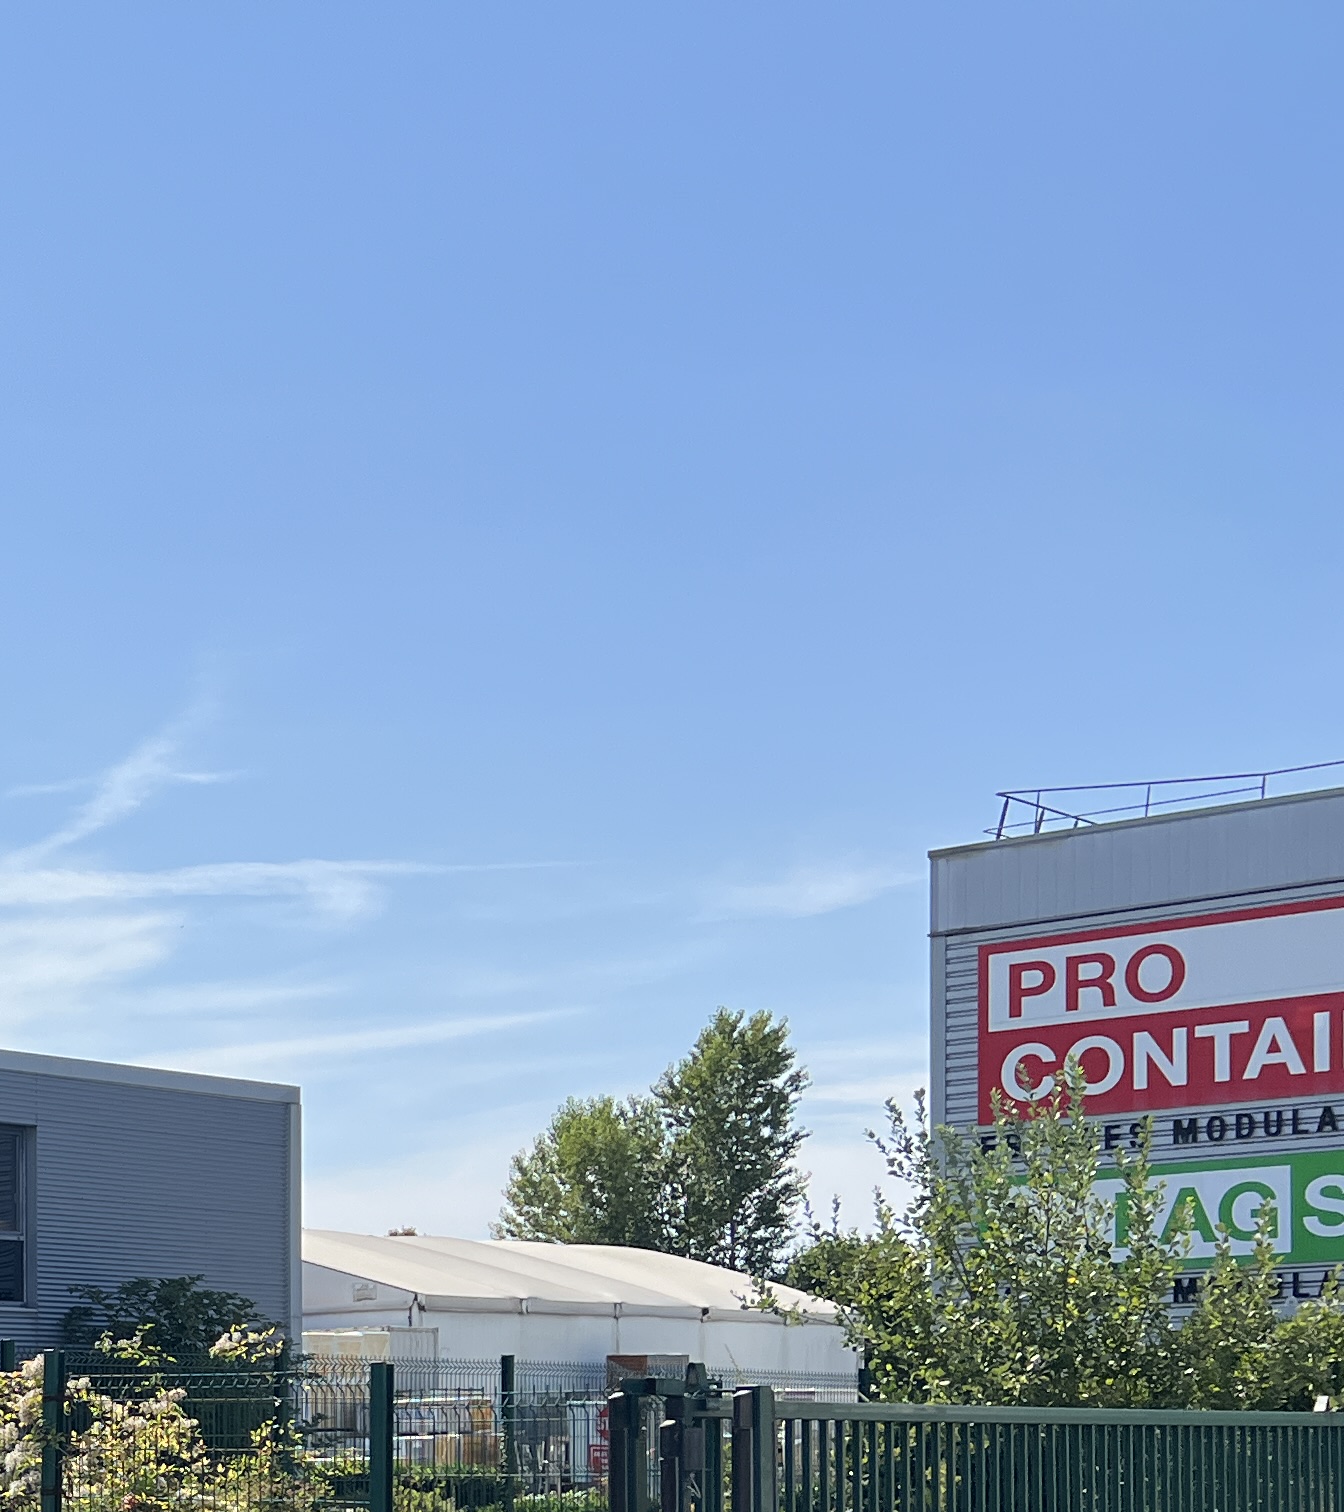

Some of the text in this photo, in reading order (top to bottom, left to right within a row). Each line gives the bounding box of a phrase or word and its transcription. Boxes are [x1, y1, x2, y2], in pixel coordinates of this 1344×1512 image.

[1008, 943, 1186, 1019] PRO
[1000, 1010, 1344, 1103] CONTAI
[1172, 1105, 1339, 1145] MODULA
